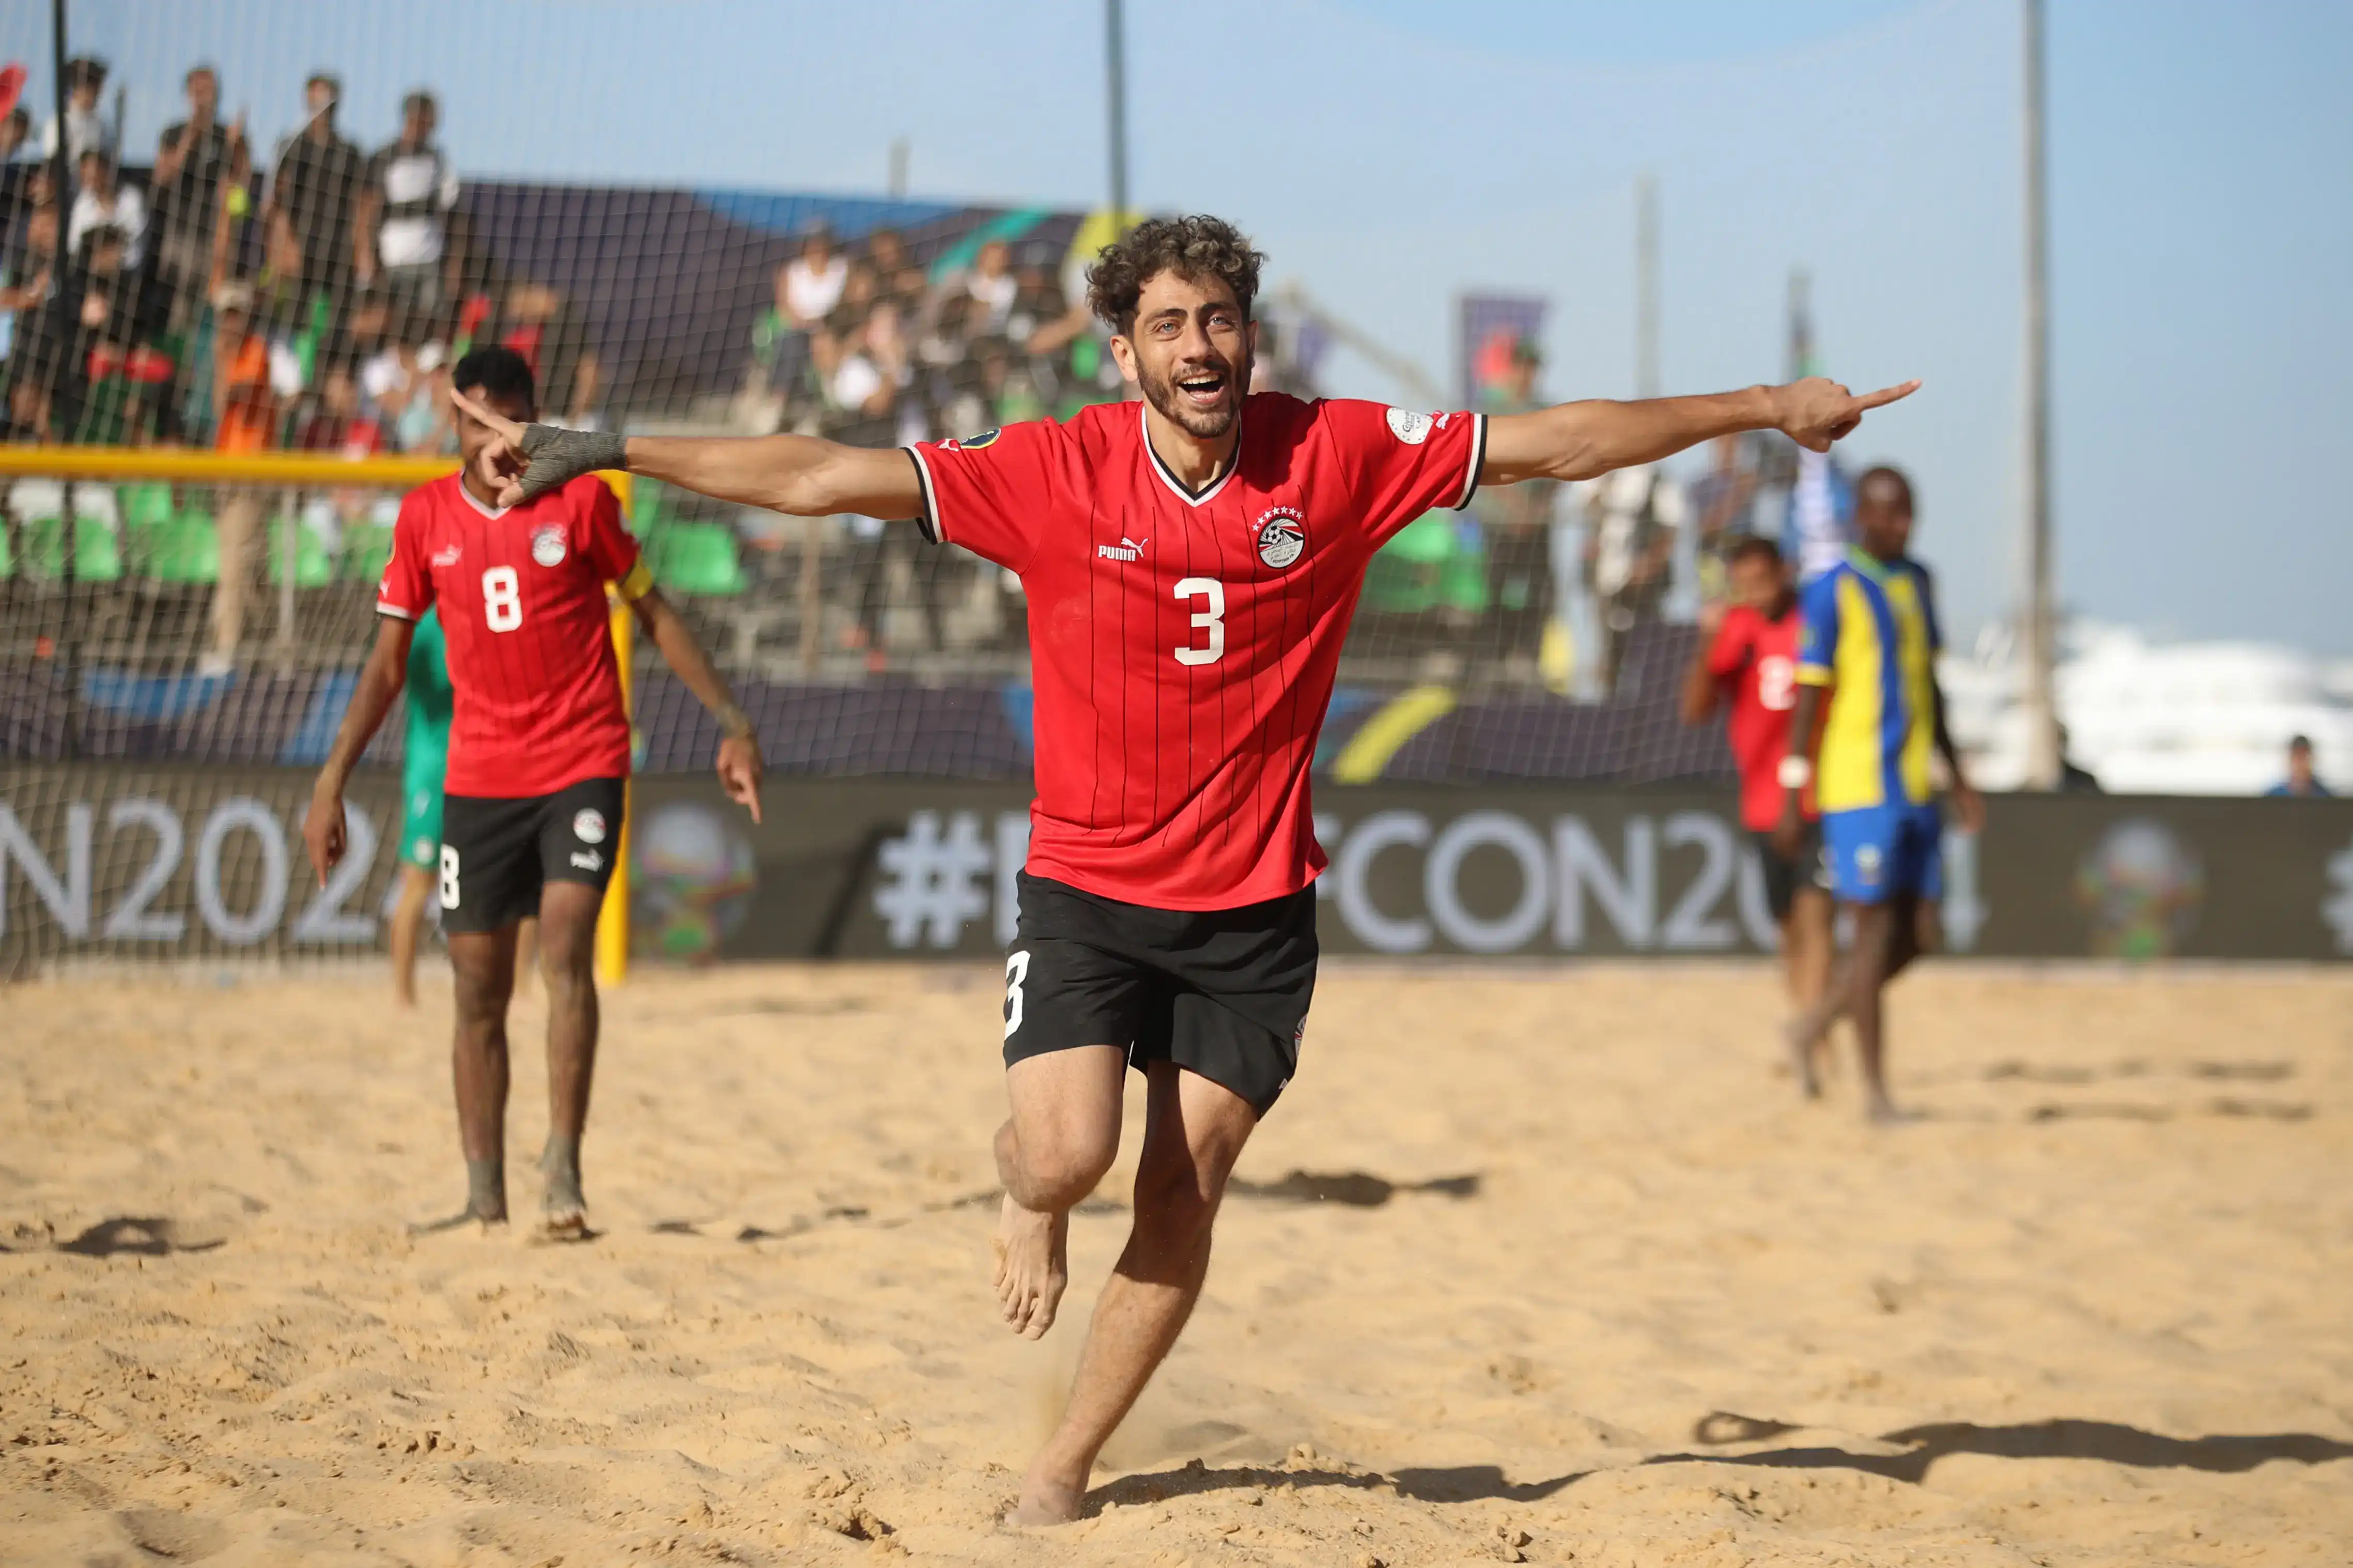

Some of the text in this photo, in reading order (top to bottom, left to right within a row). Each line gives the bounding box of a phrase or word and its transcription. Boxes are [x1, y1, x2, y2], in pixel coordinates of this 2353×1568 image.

[1098, 545, 1136, 562] PUMA
[482, 565, 522, 633] 8
[1173, 577, 1225, 665] 3
[0, 796, 455, 945] N202
[440, 844, 460, 910] 8
[1004, 950, 1031, 1040] 3
